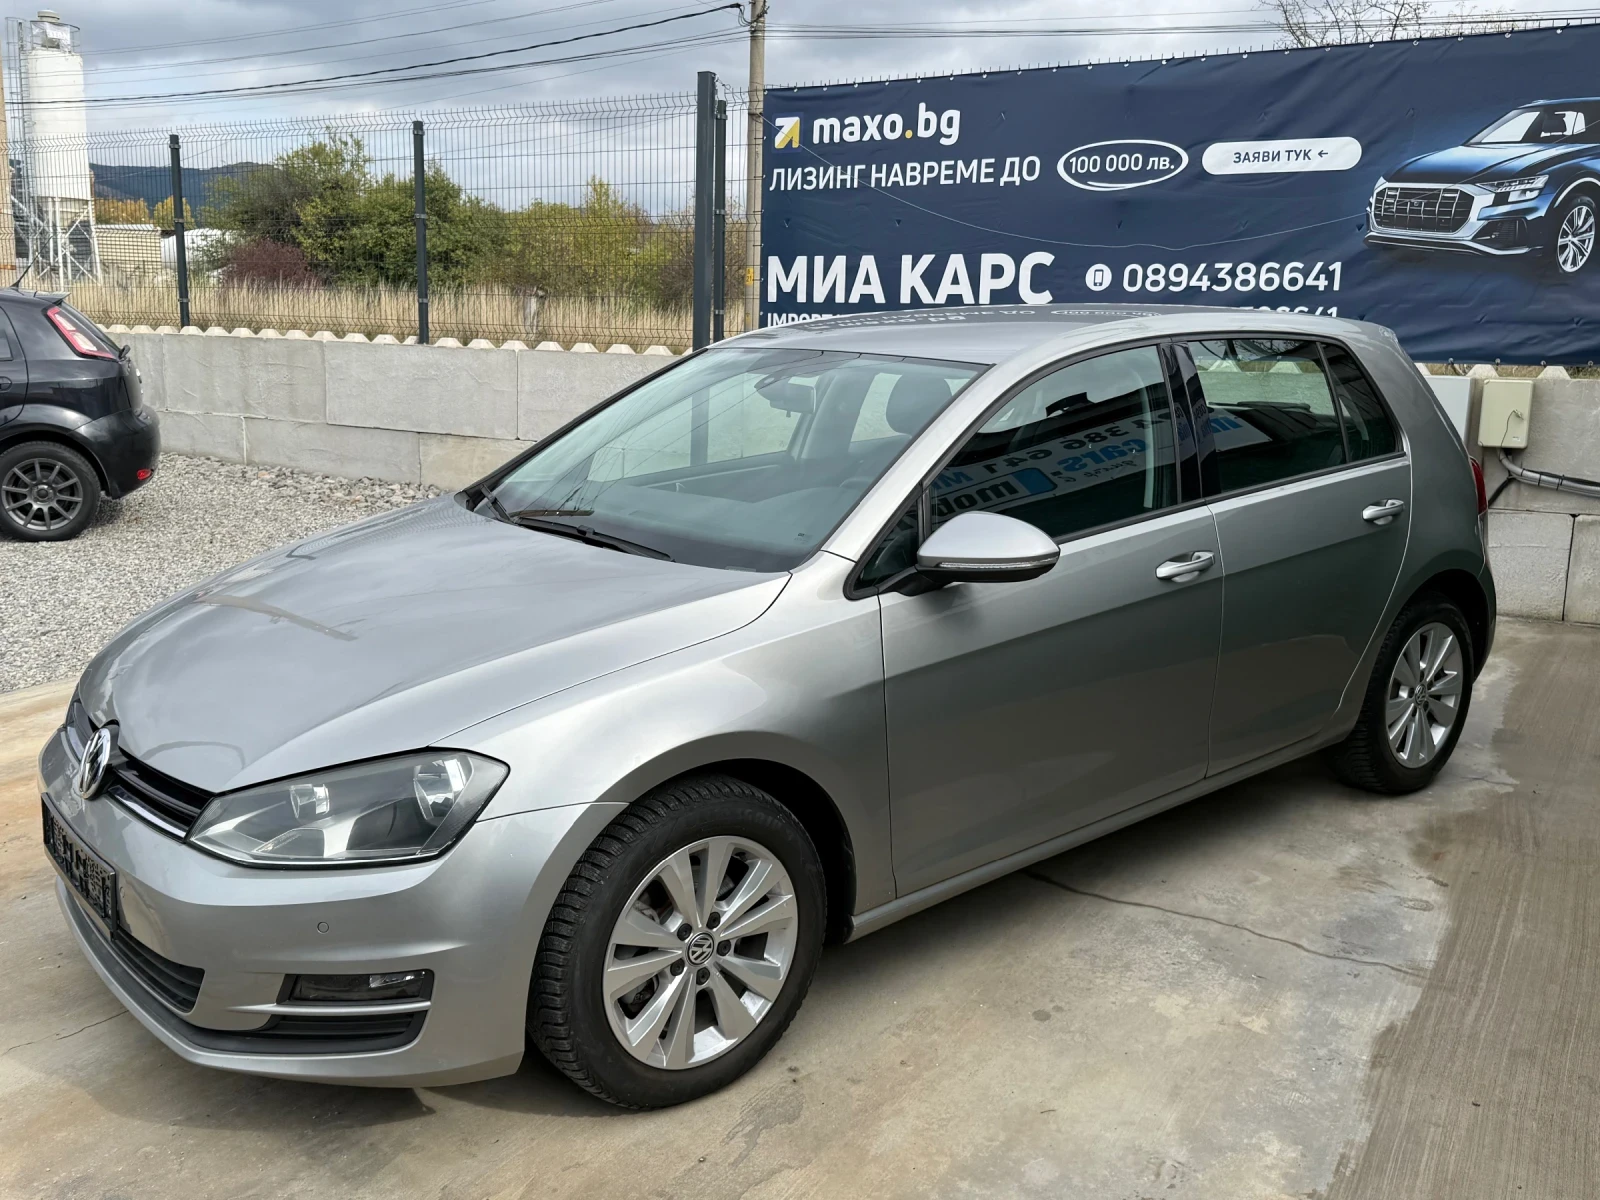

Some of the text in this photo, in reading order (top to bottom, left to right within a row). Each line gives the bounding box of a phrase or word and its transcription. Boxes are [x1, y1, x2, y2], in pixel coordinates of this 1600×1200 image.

[812, 102, 961, 146] maxo.bg
[769, 155, 1041, 192] ЛИЗИНГ НАВРЕМЕ ДО
[1069, 153, 1175, 174] 100 000 лв.
[1232, 149, 1312, 164] ЗАЯВИ ТУК
[767, 251, 1055, 305] МИА КАРС
[1122, 261, 1343, 293] 0894386641
